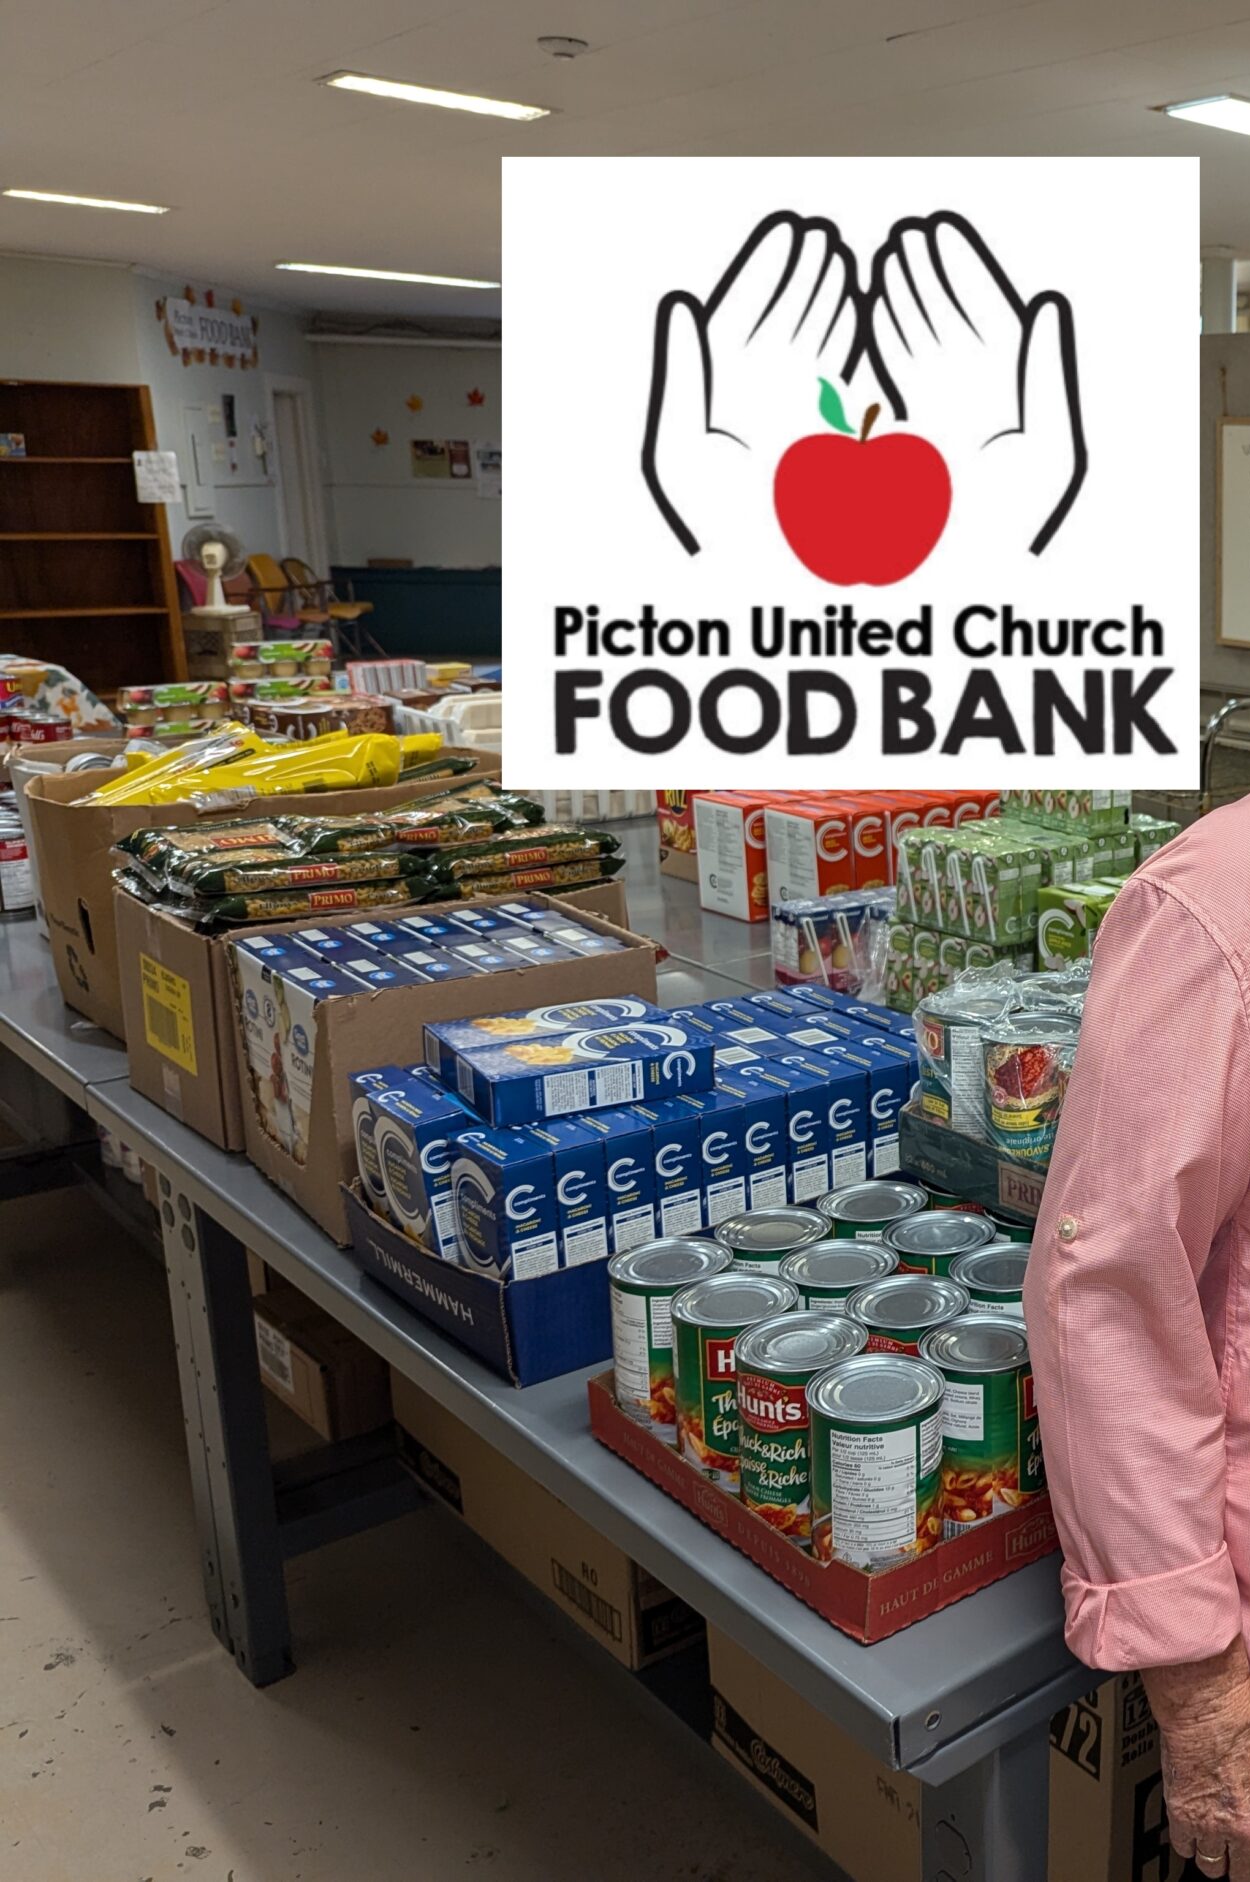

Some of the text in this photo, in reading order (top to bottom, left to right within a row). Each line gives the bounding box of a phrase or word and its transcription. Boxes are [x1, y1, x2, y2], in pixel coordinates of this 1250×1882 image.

[510, 851, 547, 866] PRIMO
[293, 866, 336, 882] PRIMO
[516, 872, 550, 886] PRIMO
[312, 891, 354, 908] PRIMO
[367, 1238, 475, 1326] HAMMERMILL
[737, 1381, 803, 1424] Hunt's
[832, 1432, 860, 1443] Nutrition
[832, 1440, 852, 1450] Valeur
[879, 1587, 919, 1616] HAUT
[943, 1551, 994, 1584] GAMME
[1121, 1739, 1155, 1767] Rolls
